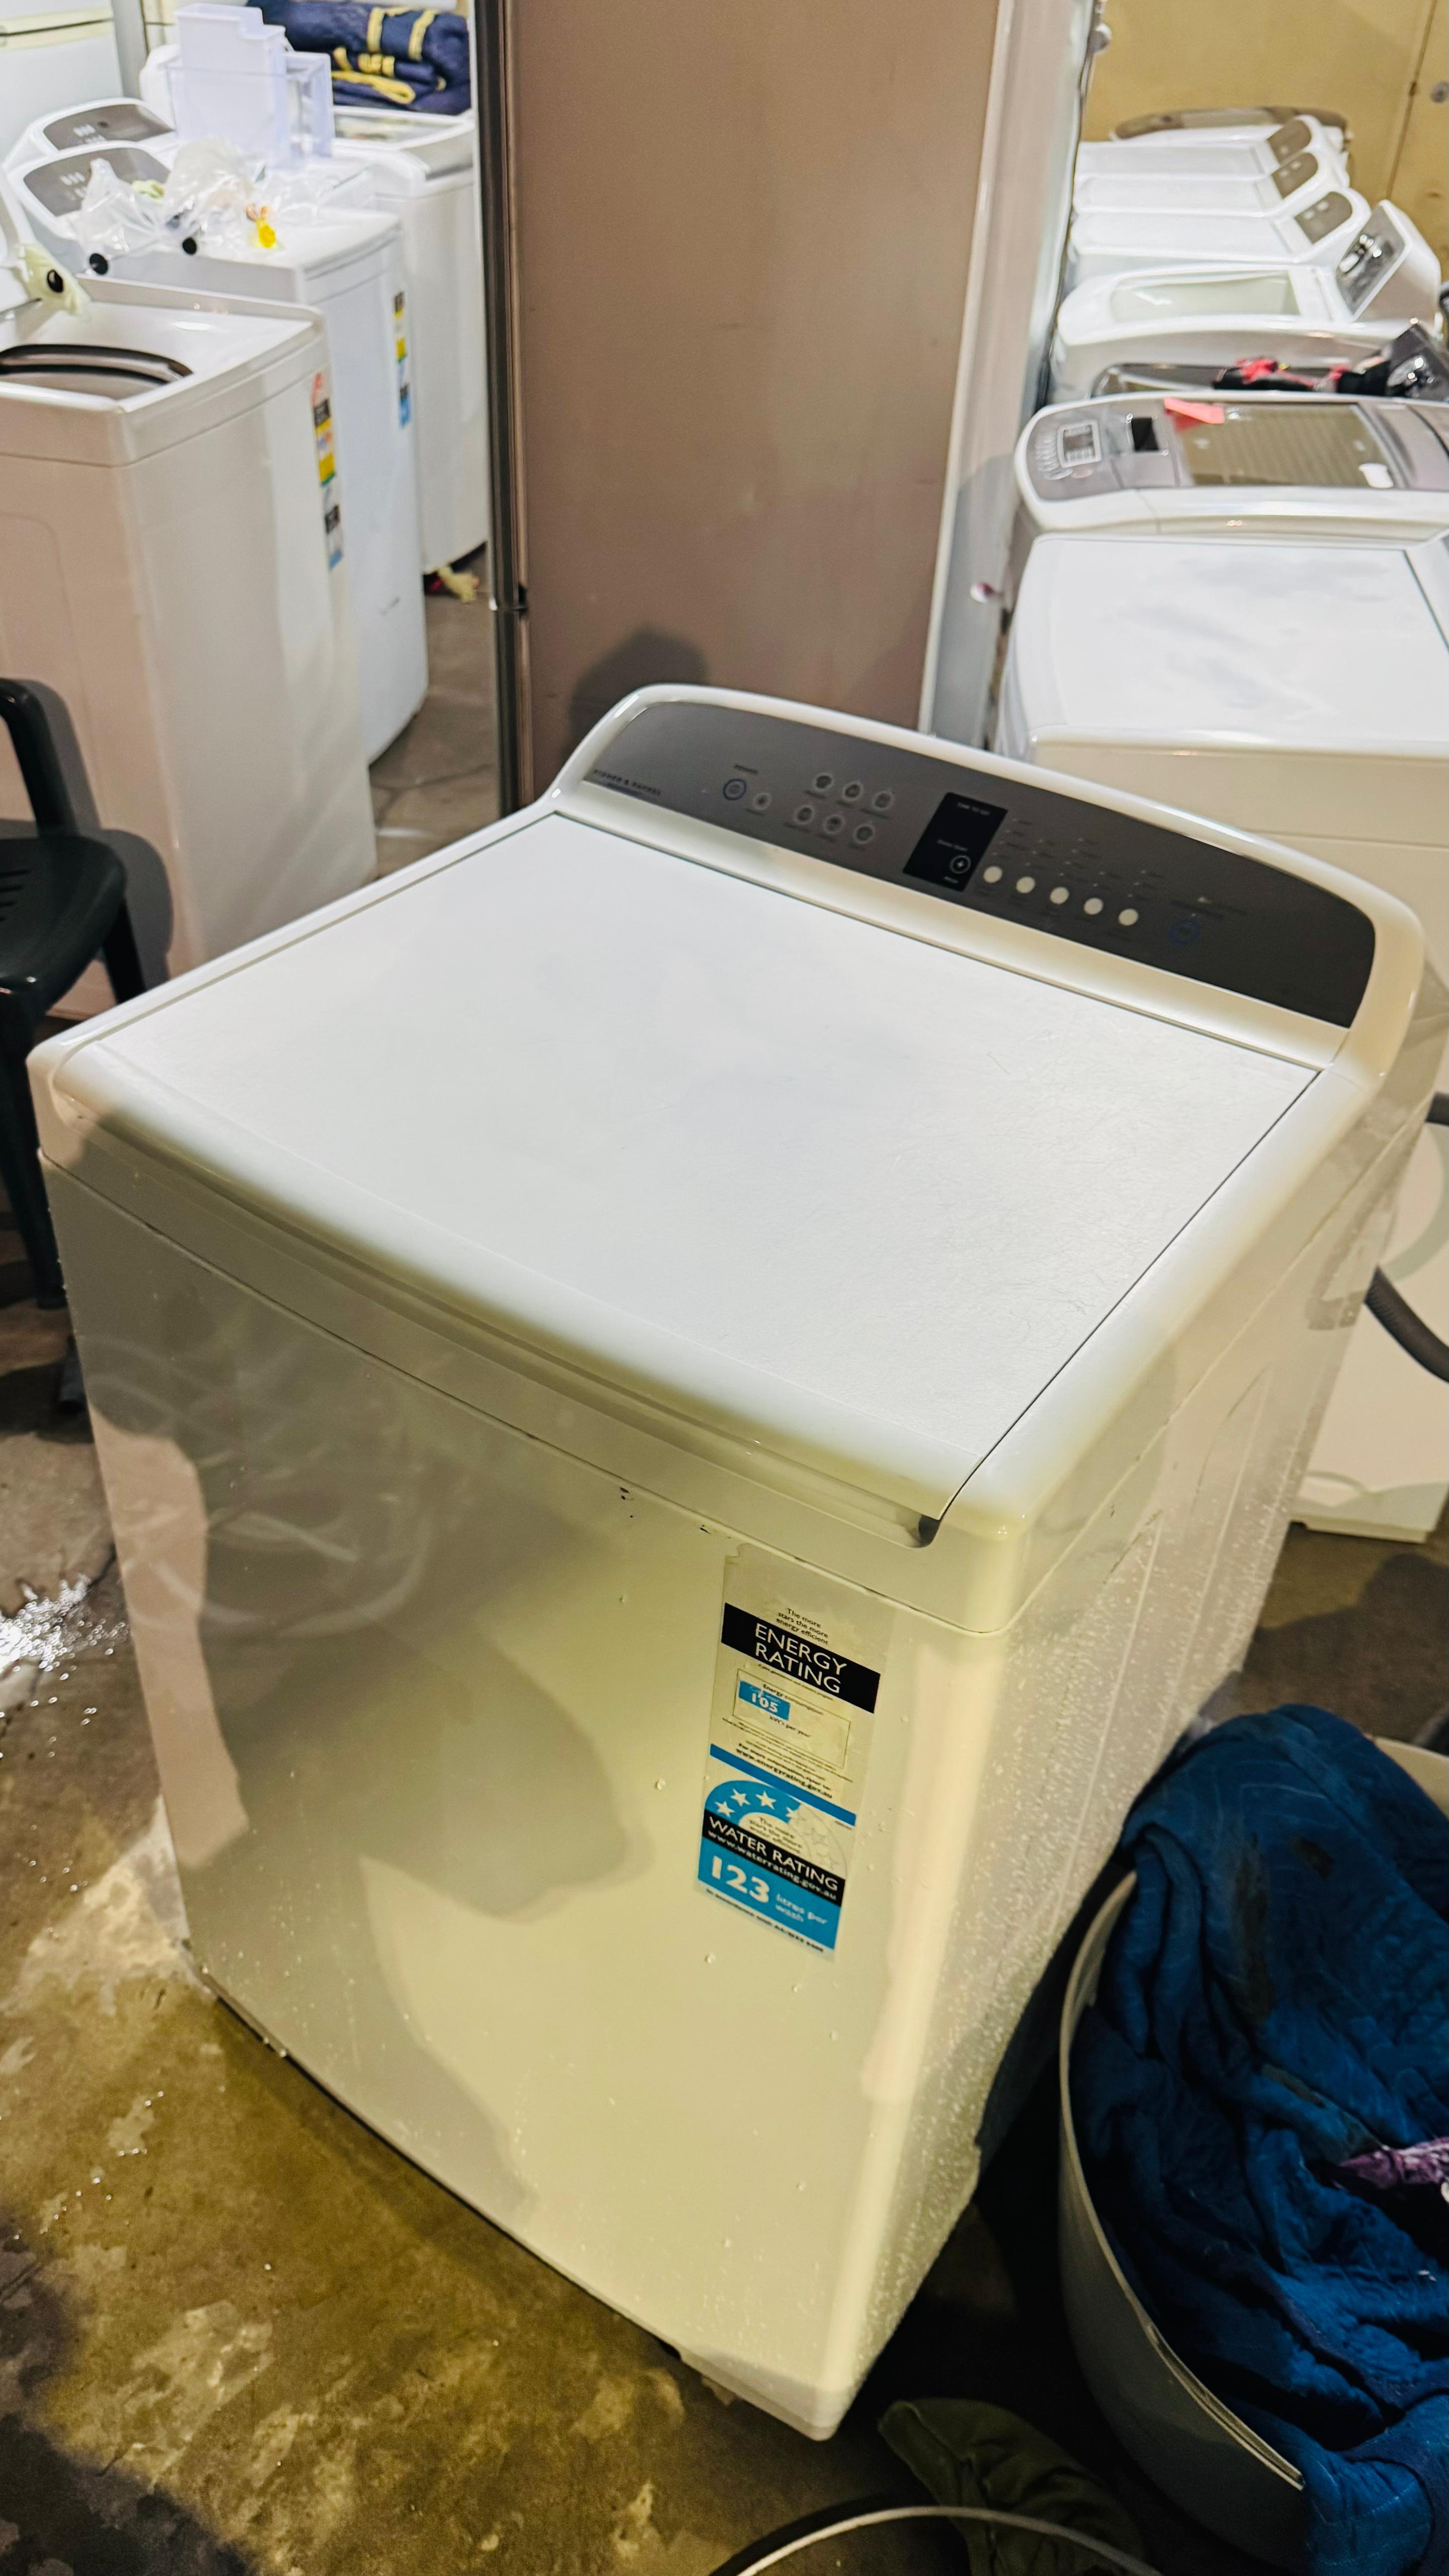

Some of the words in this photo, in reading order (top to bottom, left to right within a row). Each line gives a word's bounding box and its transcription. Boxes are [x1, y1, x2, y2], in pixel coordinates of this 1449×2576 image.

[776, 1618, 799, 1632] energy
[801, 1630, 829, 1645] efficient
[778, 1612, 794, 1623] stars
[796, 1620, 808, 1629] the
[809, 1627, 828, 1639] more
[787, 1607, 800, 1619] The
[801, 1617, 821, 1628] more
[755, 1623, 847, 1675] ENERGY
[755, 1642, 841, 1694] RATING
[752, 1693, 779, 1714] 105
[708, 1830, 837, 1901] www.waterrating.gov.au
[709, 1816, 767, 1856] WATER
[772, 1849, 839, 1891] RATING
[712, 1855, 770, 1903] 123
